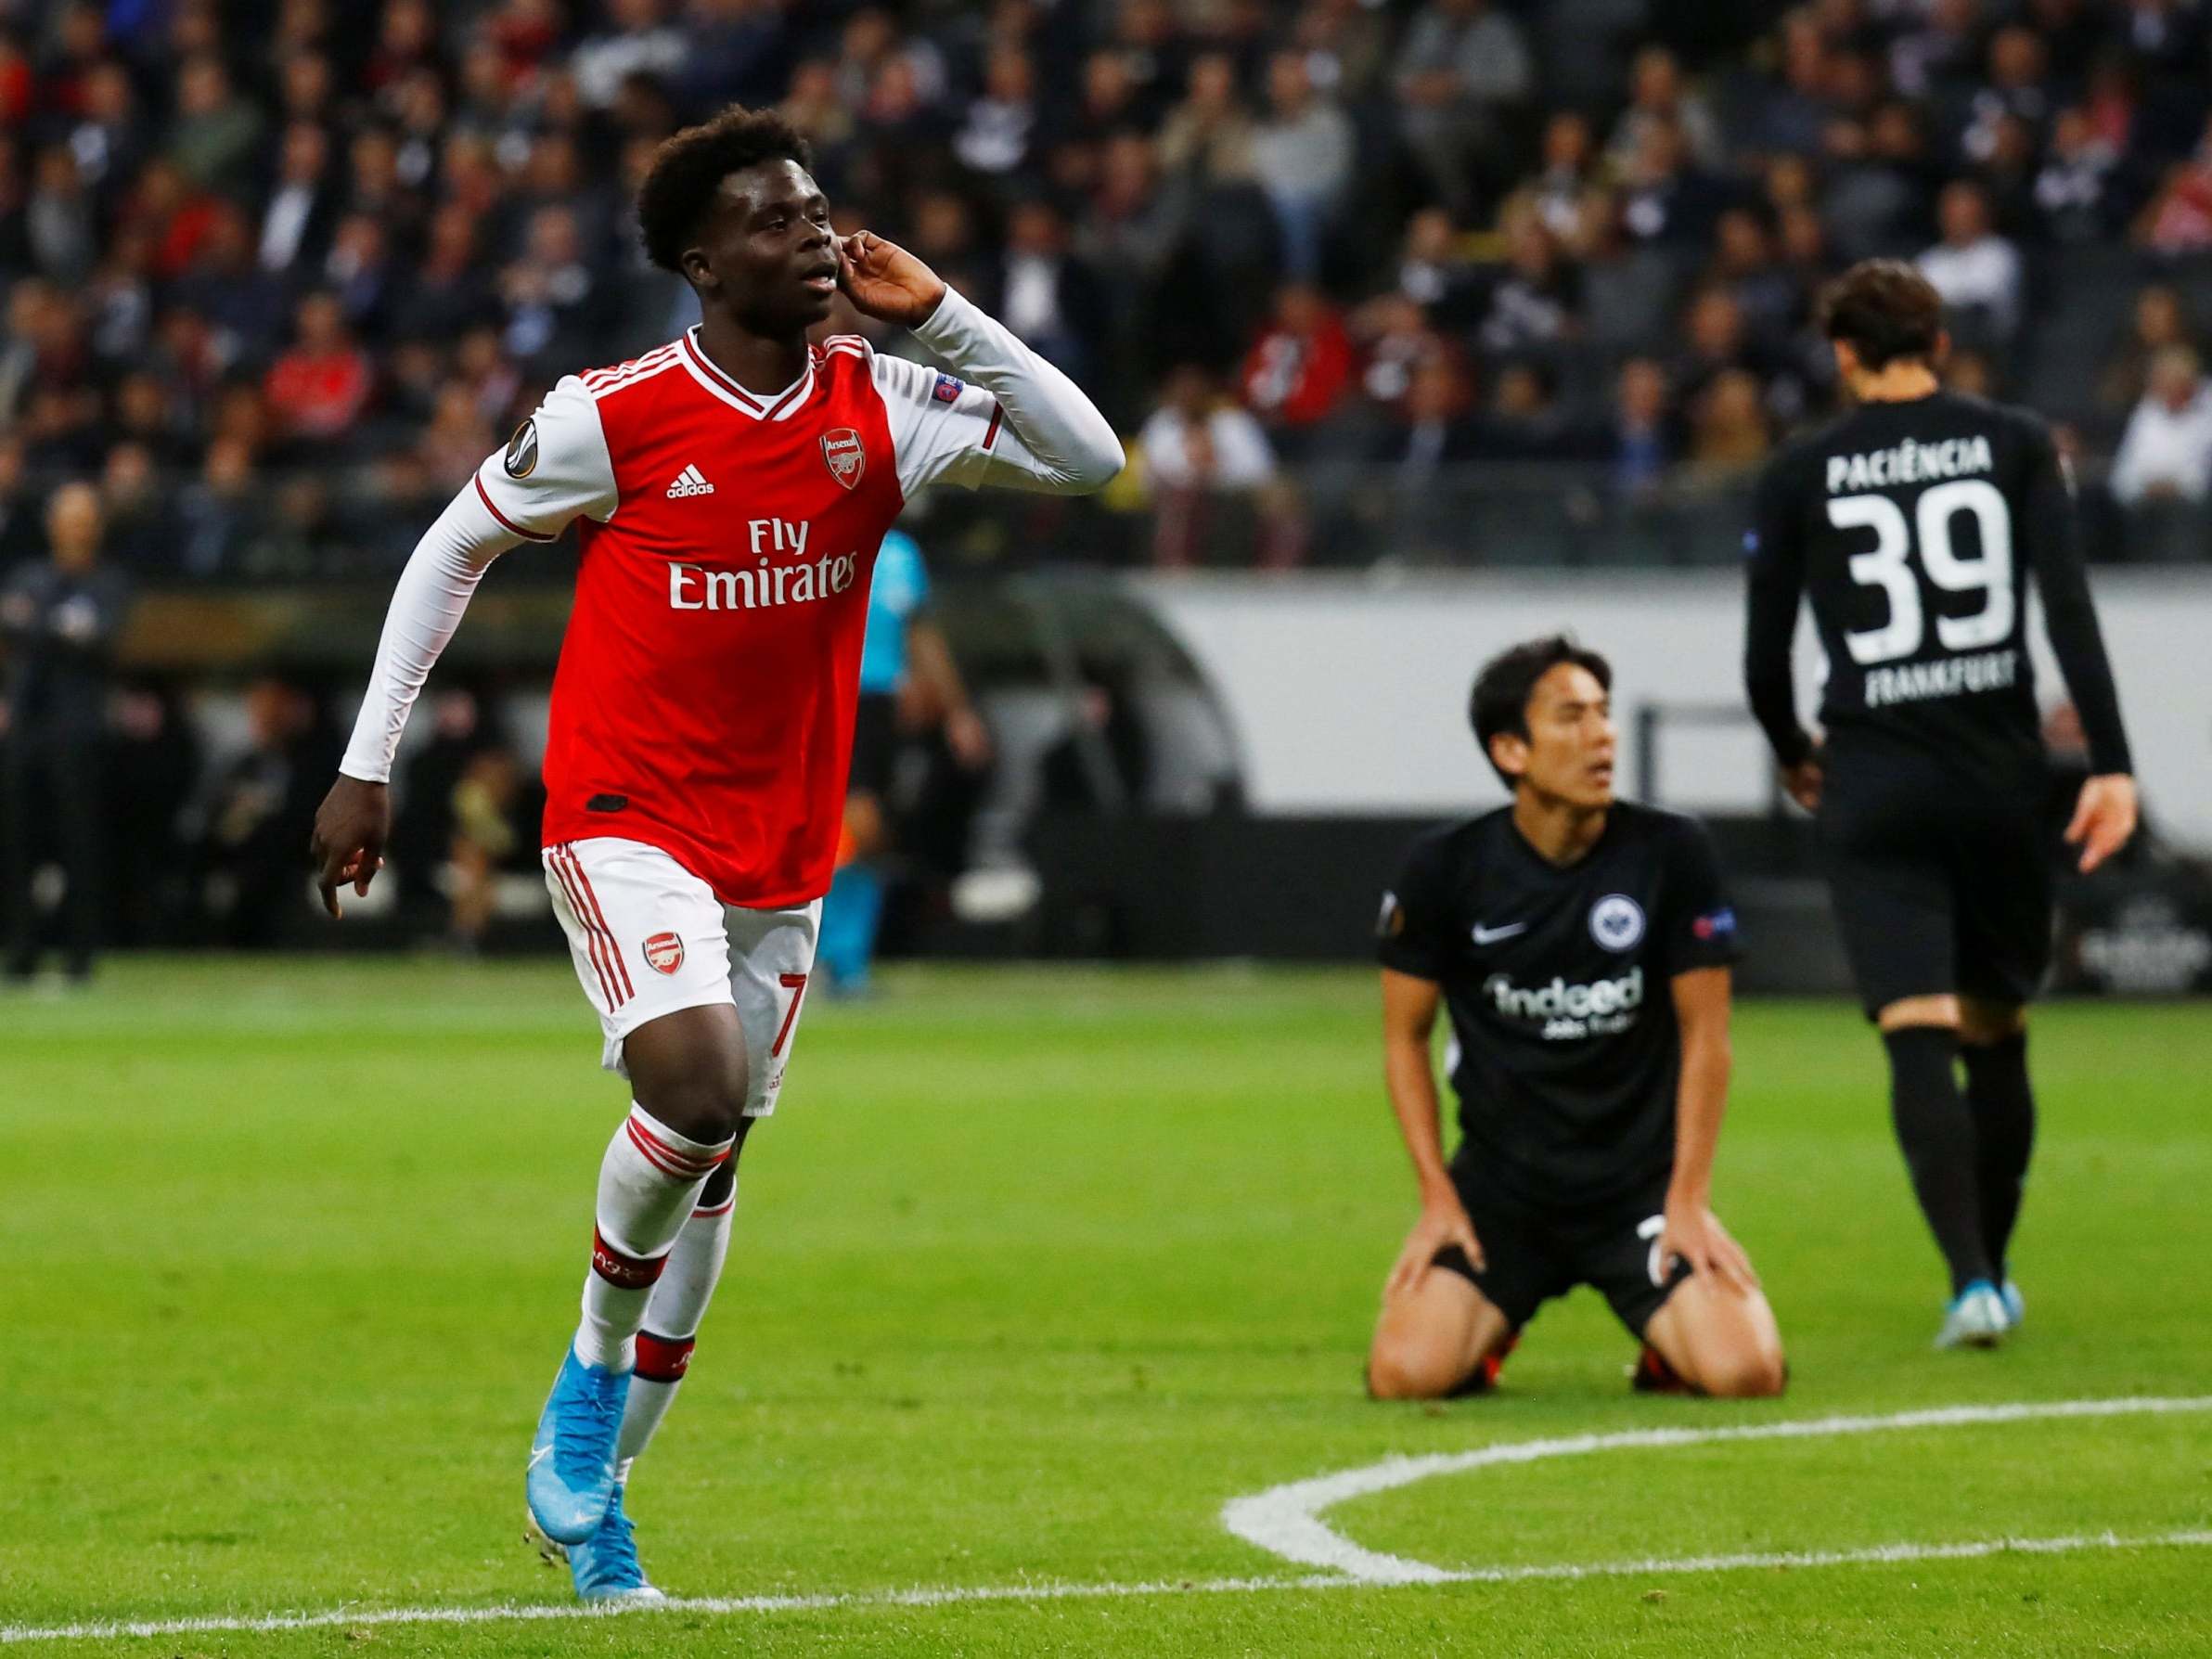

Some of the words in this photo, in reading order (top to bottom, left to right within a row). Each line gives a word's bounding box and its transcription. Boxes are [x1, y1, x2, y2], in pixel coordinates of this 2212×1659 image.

[826, 438, 856, 451] Arsenal
[1826, 437, 1993, 494] PACIÊNCIA
[666, 482, 714, 498] adidas
[748, 518, 809, 555] Fly
[668, 551, 855, 610] Emirates
[1827, 479, 2015, 665] 39
[1864, 650, 2016, 708] FRANKFURT
